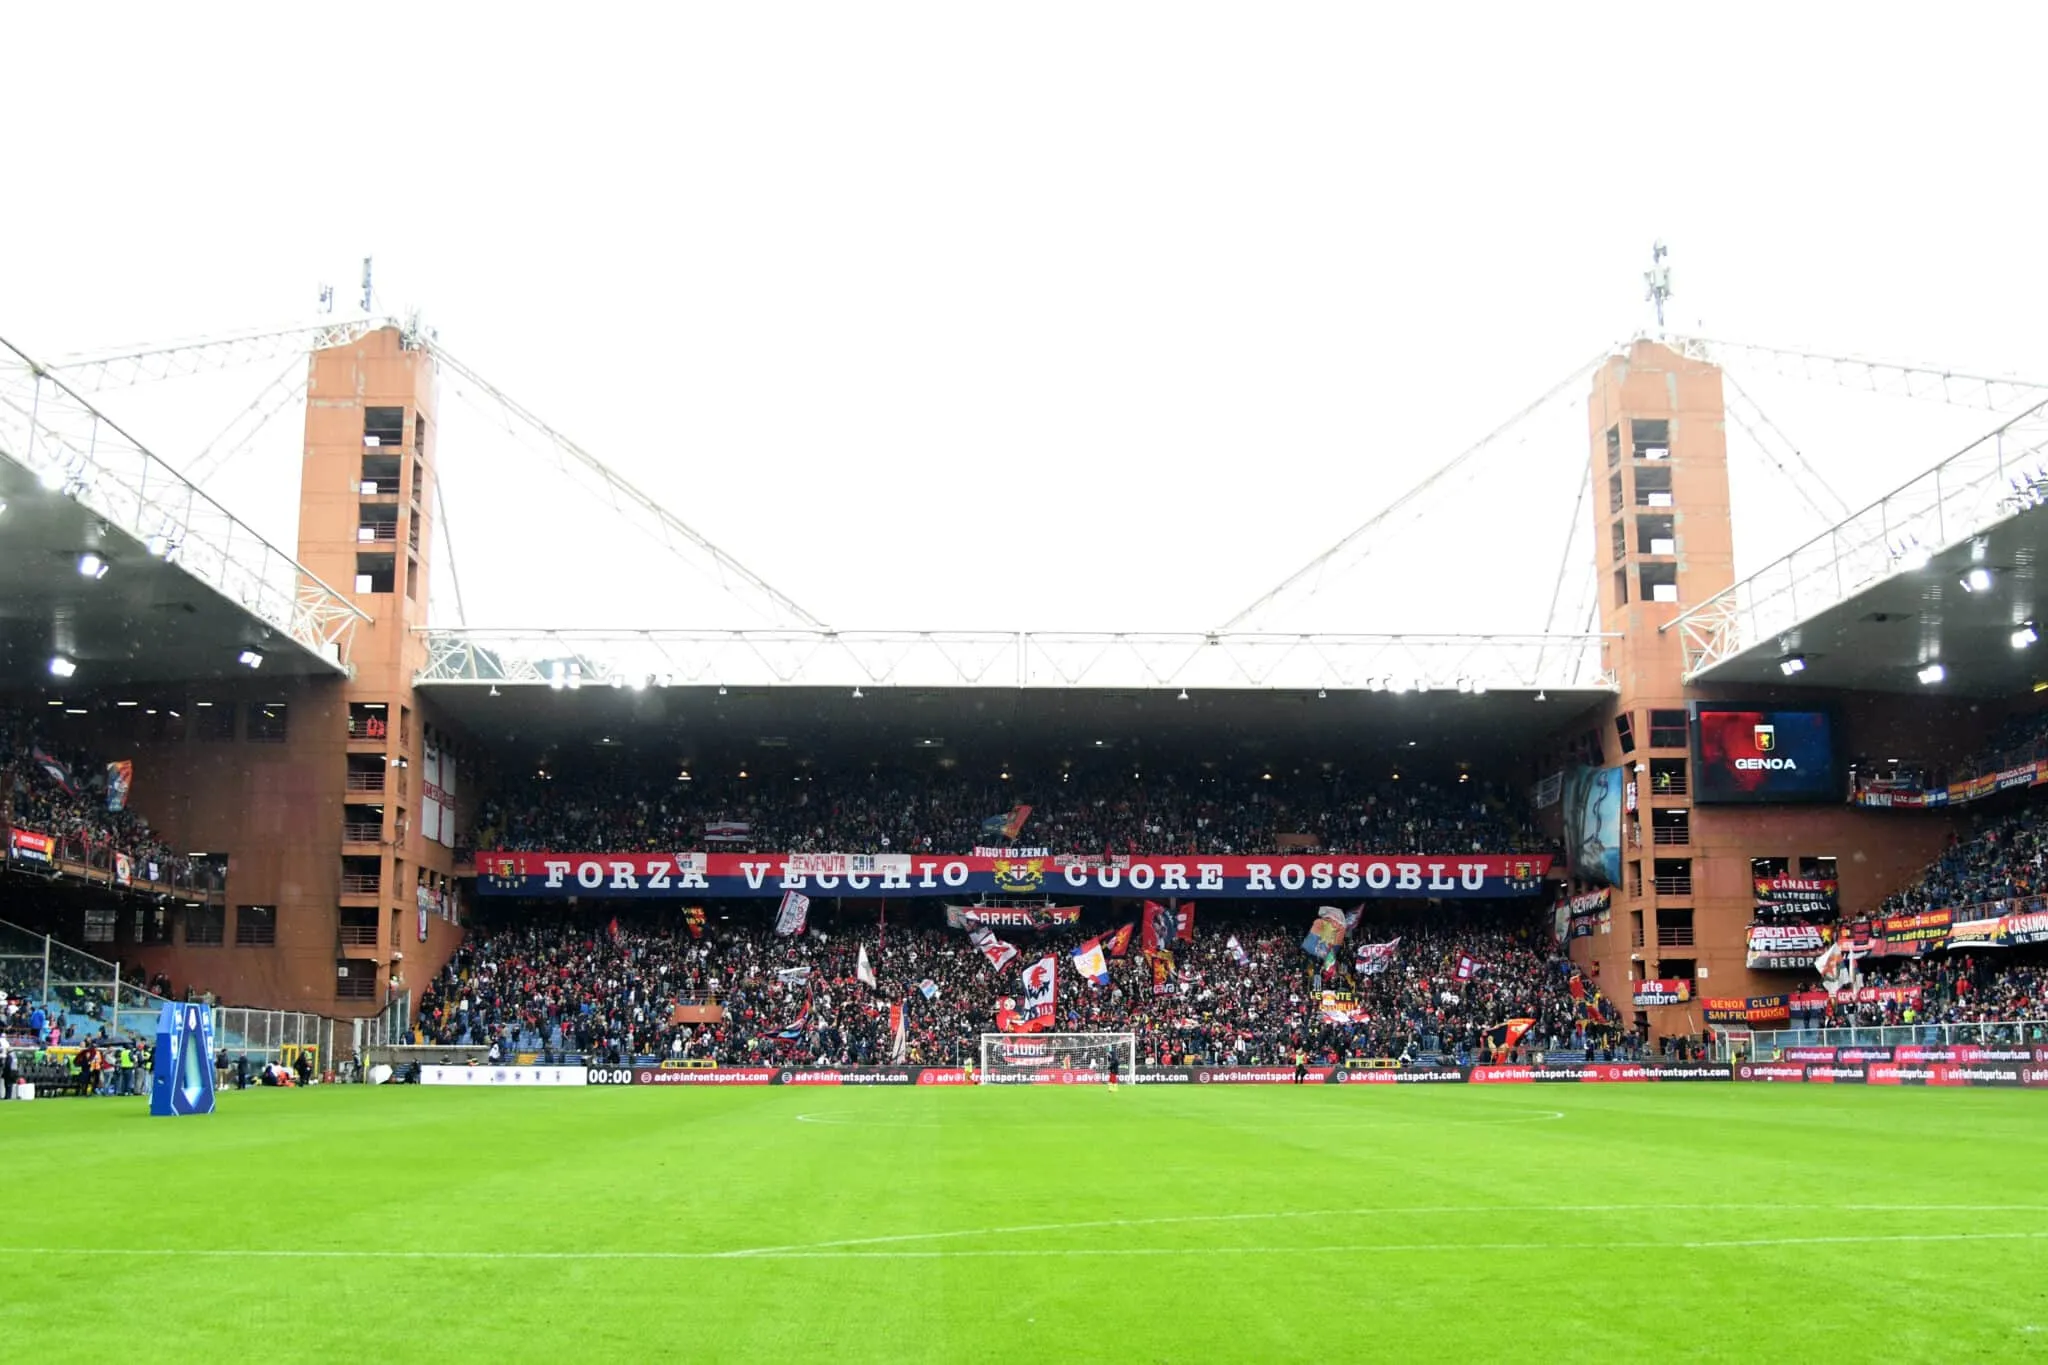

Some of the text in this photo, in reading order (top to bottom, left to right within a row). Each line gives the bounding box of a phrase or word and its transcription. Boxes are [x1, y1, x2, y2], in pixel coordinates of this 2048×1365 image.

[1735, 758, 1797, 770] GENOA
[1020, 847, 1050, 858] ZENA
[792, 855, 846, 872] BENVENUTA
[544, 861, 710, 889] FORZA
[738, 861, 970, 890] VECCHIO
[1064, 862, 1224, 891] CUORE
[1246, 862, 1488, 891] ROSSOBLU
[1773, 880, 1822, 890] CANALE
[1751, 926, 1820, 938] ENOA CLUB
[1749, 937, 1823, 951] MASSA
[1310, 991, 1353, 1001] LENTE
[1710, 999, 1745, 1010] GENOA
[1751, 996, 1780, 1008] CLUB
[1708, 1007, 1785, 1020] SAN FRUTTUOSO
[588, 1070, 632, 1085] 00:00
[654, 1072, 770, 1084] adv@infrontsports.com
[795, 1072, 909, 1084] adv@infrontsports.com
[936, 1072, 1050, 1085] adv@ifrontsports.com
[1350, 1070, 1462, 1081] adv@infrontsports.com
[1487, 1068, 1598, 1080] adv@infrontsports.com
[1622, 1067, 1731, 1079] adv@infrontsports.com
